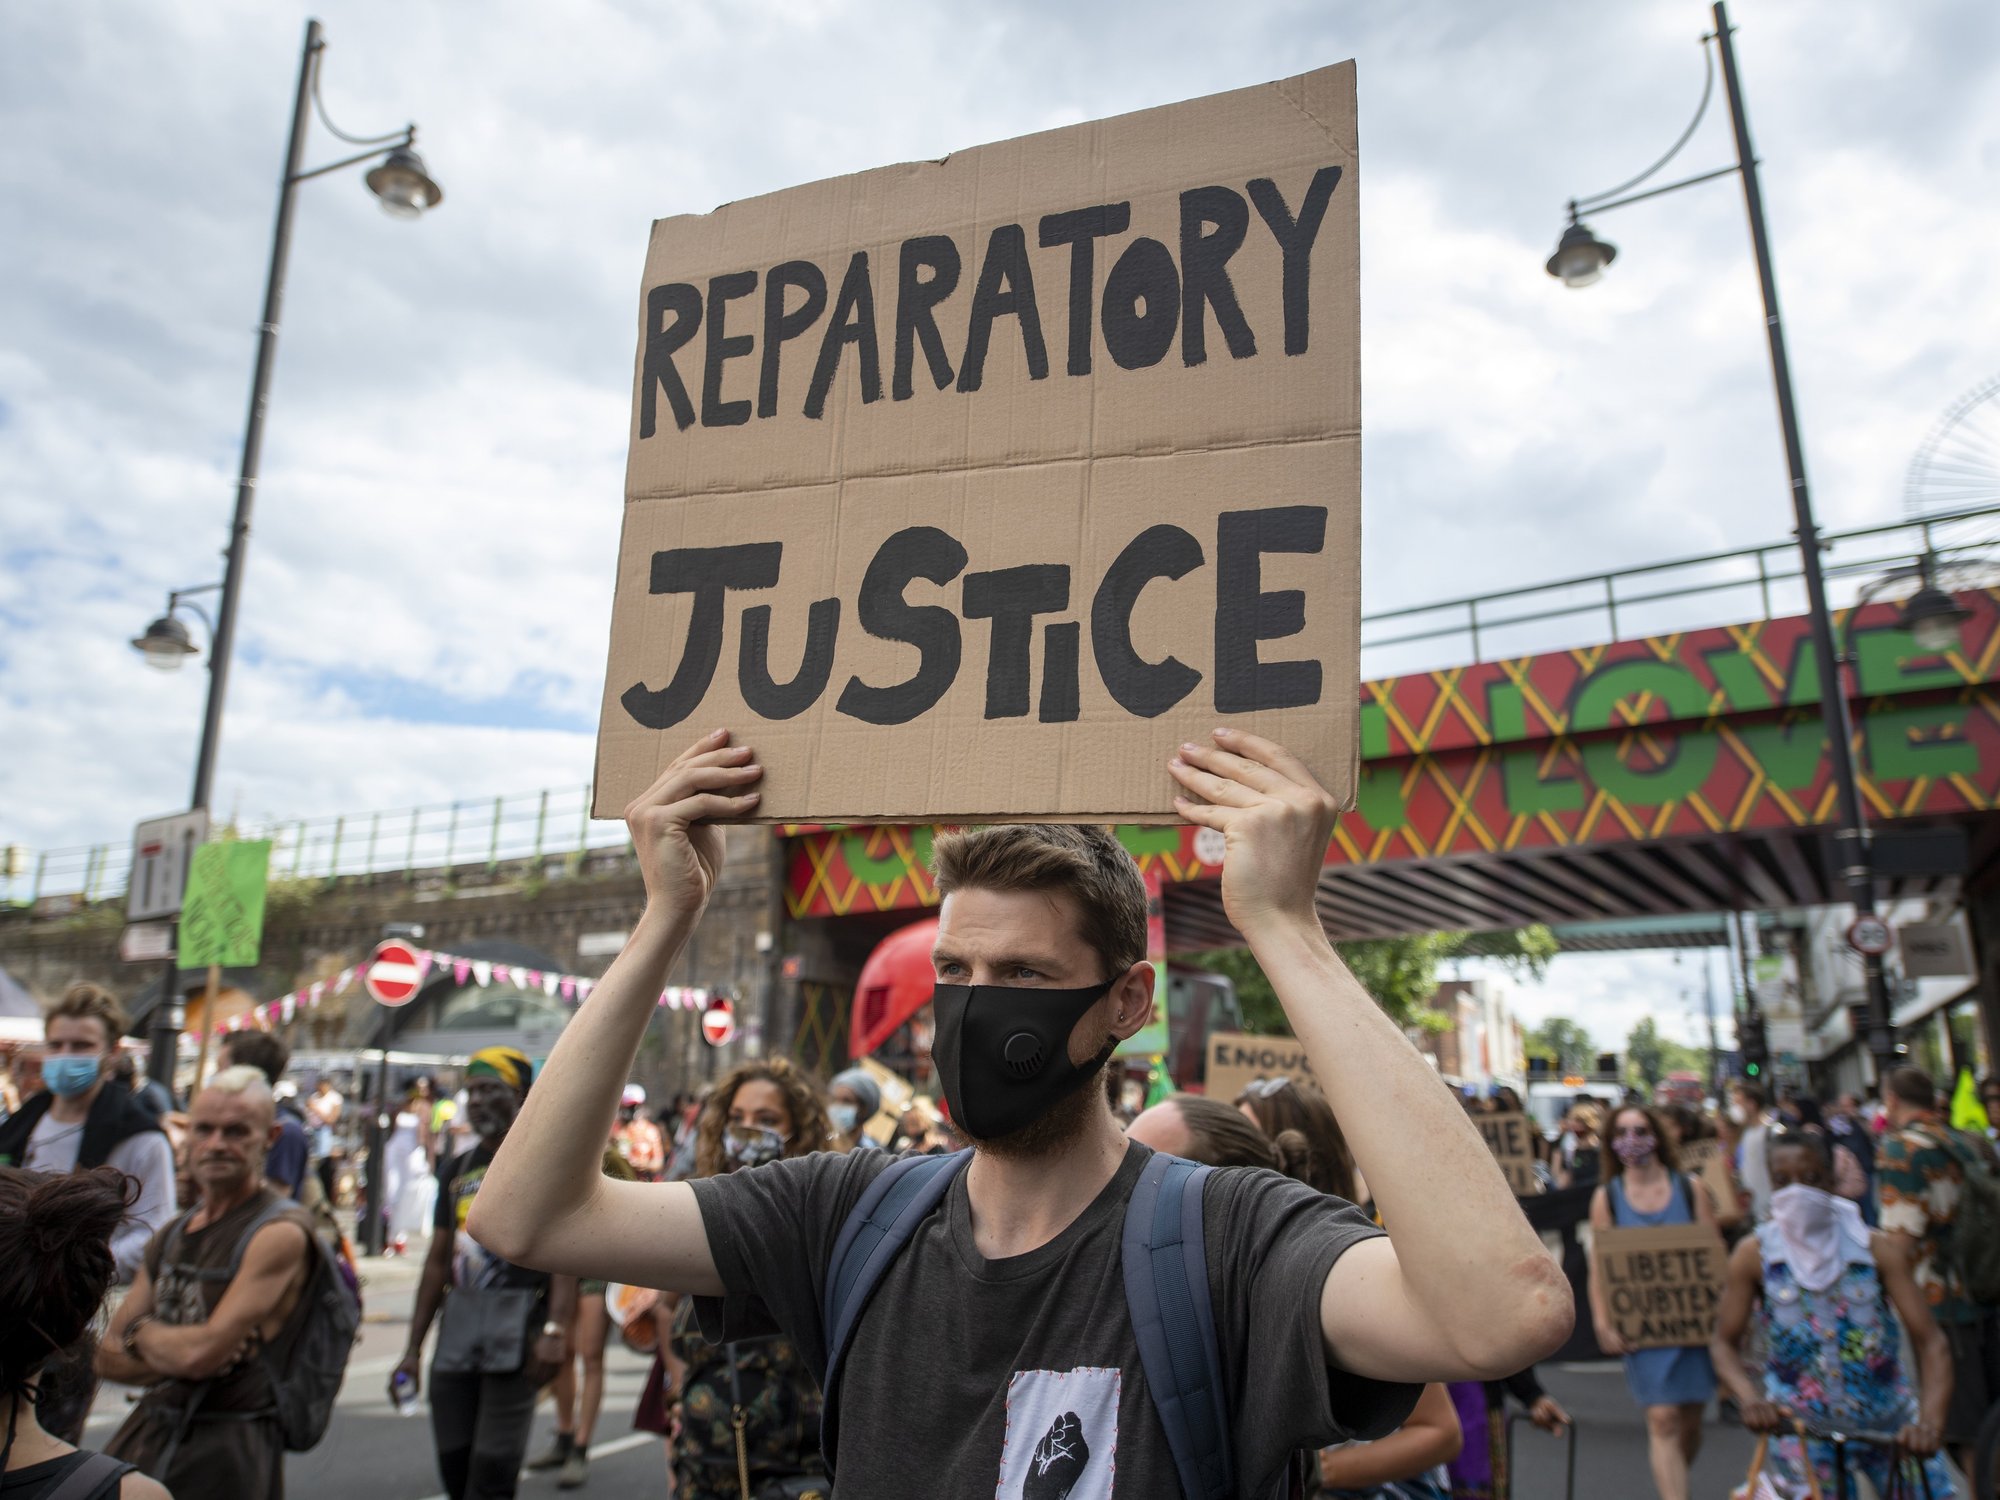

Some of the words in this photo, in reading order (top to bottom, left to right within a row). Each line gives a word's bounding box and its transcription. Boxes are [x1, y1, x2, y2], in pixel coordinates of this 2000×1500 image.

[639, 165, 1343, 439] REPARATORY
[620, 505, 1328, 730] JUSTICE
[1487, 622, 1981, 817] LOVE
[1604, 1247, 1713, 1284] LIBETE
